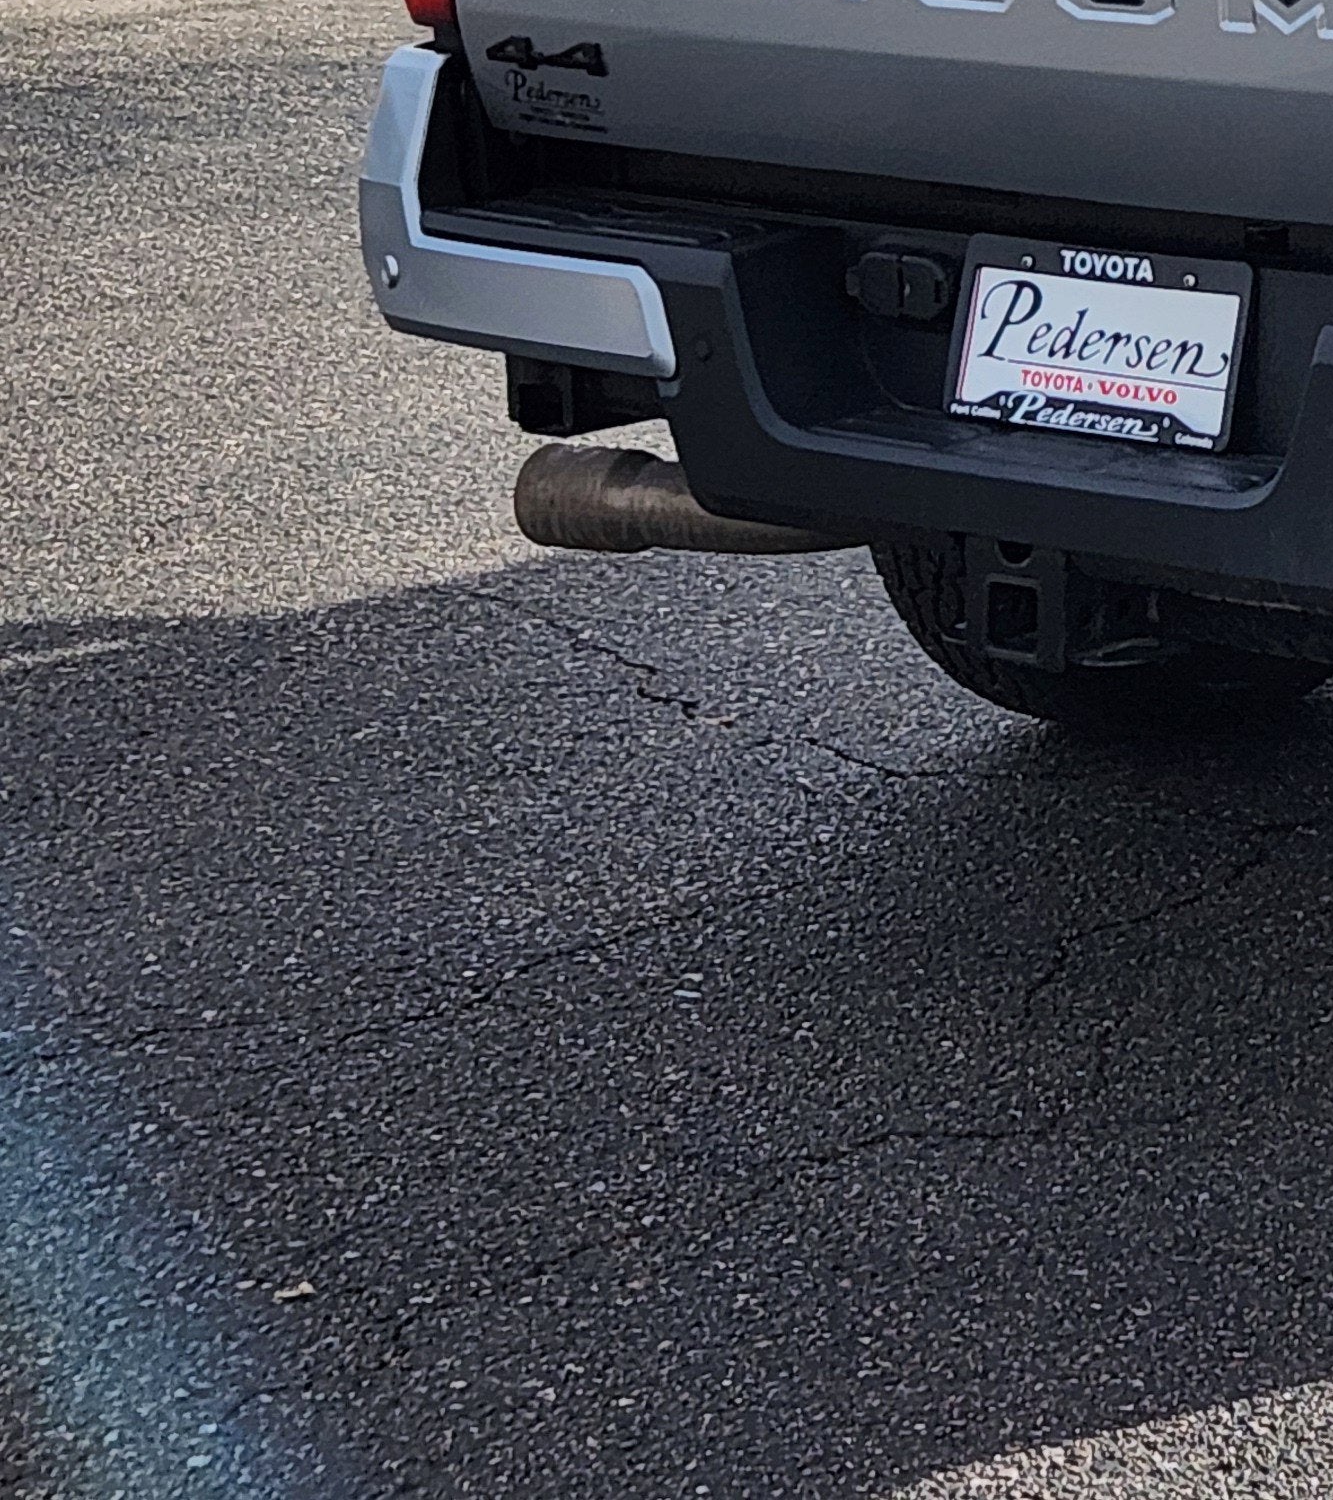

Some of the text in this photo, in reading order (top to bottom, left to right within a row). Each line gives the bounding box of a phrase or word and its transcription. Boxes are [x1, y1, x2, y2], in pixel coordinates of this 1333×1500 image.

[1060, 249, 1154, 283] TOYOTA
[977, 280, 1229, 378] Pedersen
[1021, 368, 1178, 405] TOYOTA VOLVO
[1007, 390, 1159, 436] Pedersen
